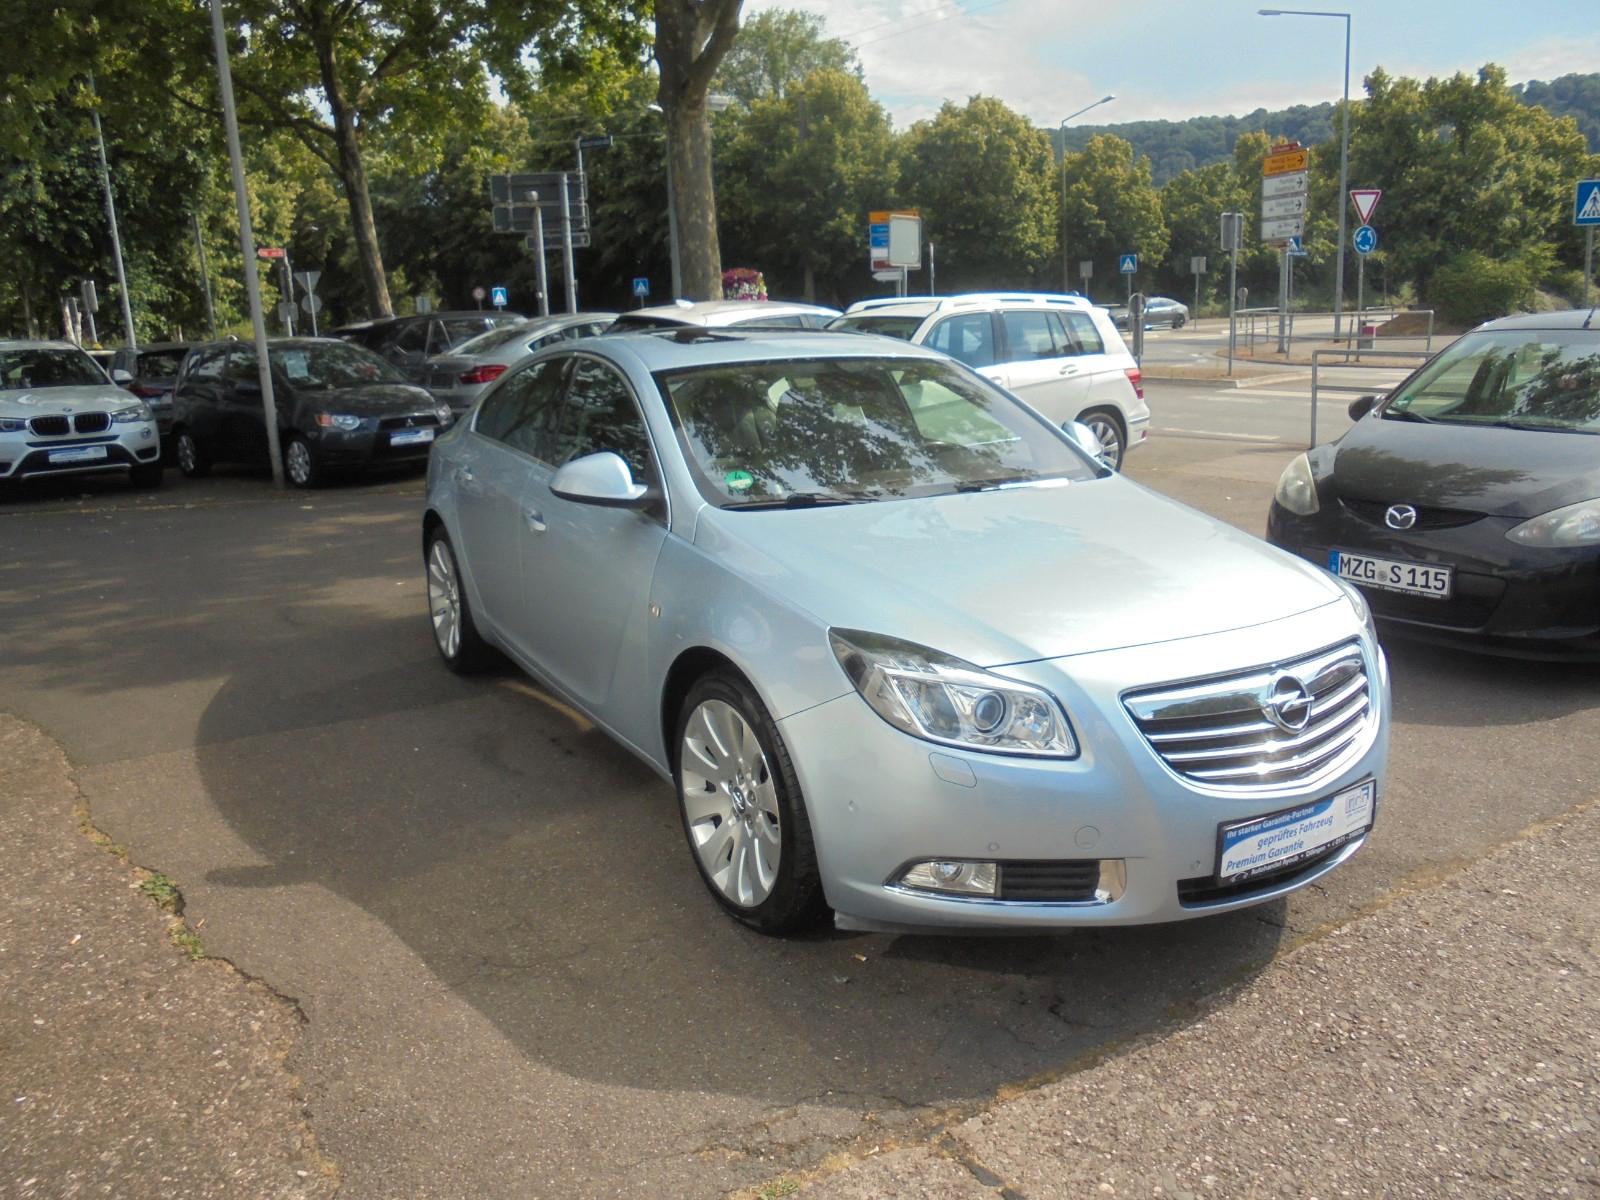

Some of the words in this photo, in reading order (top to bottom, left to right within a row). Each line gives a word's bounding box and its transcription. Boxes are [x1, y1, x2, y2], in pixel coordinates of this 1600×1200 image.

[1340, 556, 1375, 580] MZG
[1389, 565, 1402, 583] S
[1407, 568, 1447, 591] 115
[1227, 829, 1237, 839] Ihr
[1238, 823, 1262, 837] starker
[1263, 807, 1315, 829] Garantie-Partner
[1257, 828, 1298, 850] geprüftes
[1299, 814, 1334, 833] Fahrzeug
[1226, 852, 1266, 872] Premium
[1268, 839, 1304, 858] Garantie
